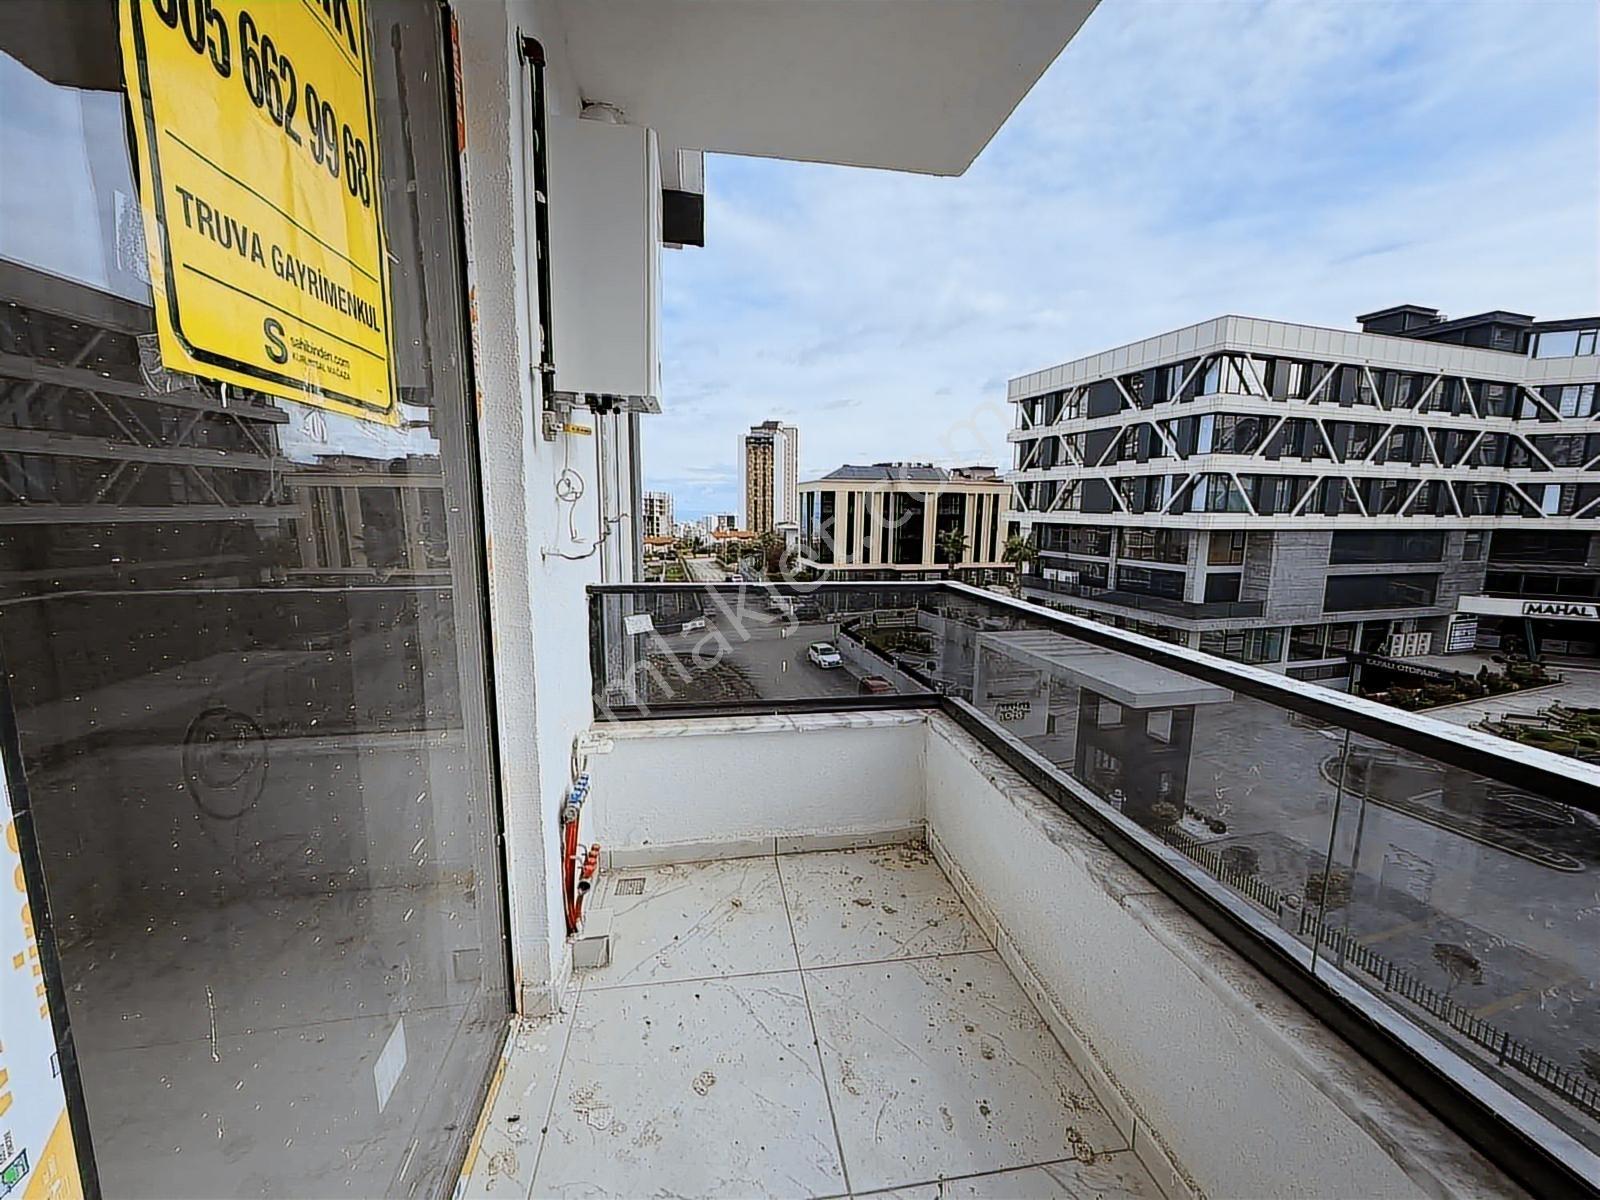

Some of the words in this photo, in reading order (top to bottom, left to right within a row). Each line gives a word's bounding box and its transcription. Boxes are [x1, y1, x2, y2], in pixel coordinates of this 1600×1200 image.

[239, 11, 302, 147] 662
[305, 83, 340, 179] 99
[343, 124, 370, 208] 68
[175, 185, 266, 268] TRUVA
[272, 244, 381, 332] GAYRİMENKUL
